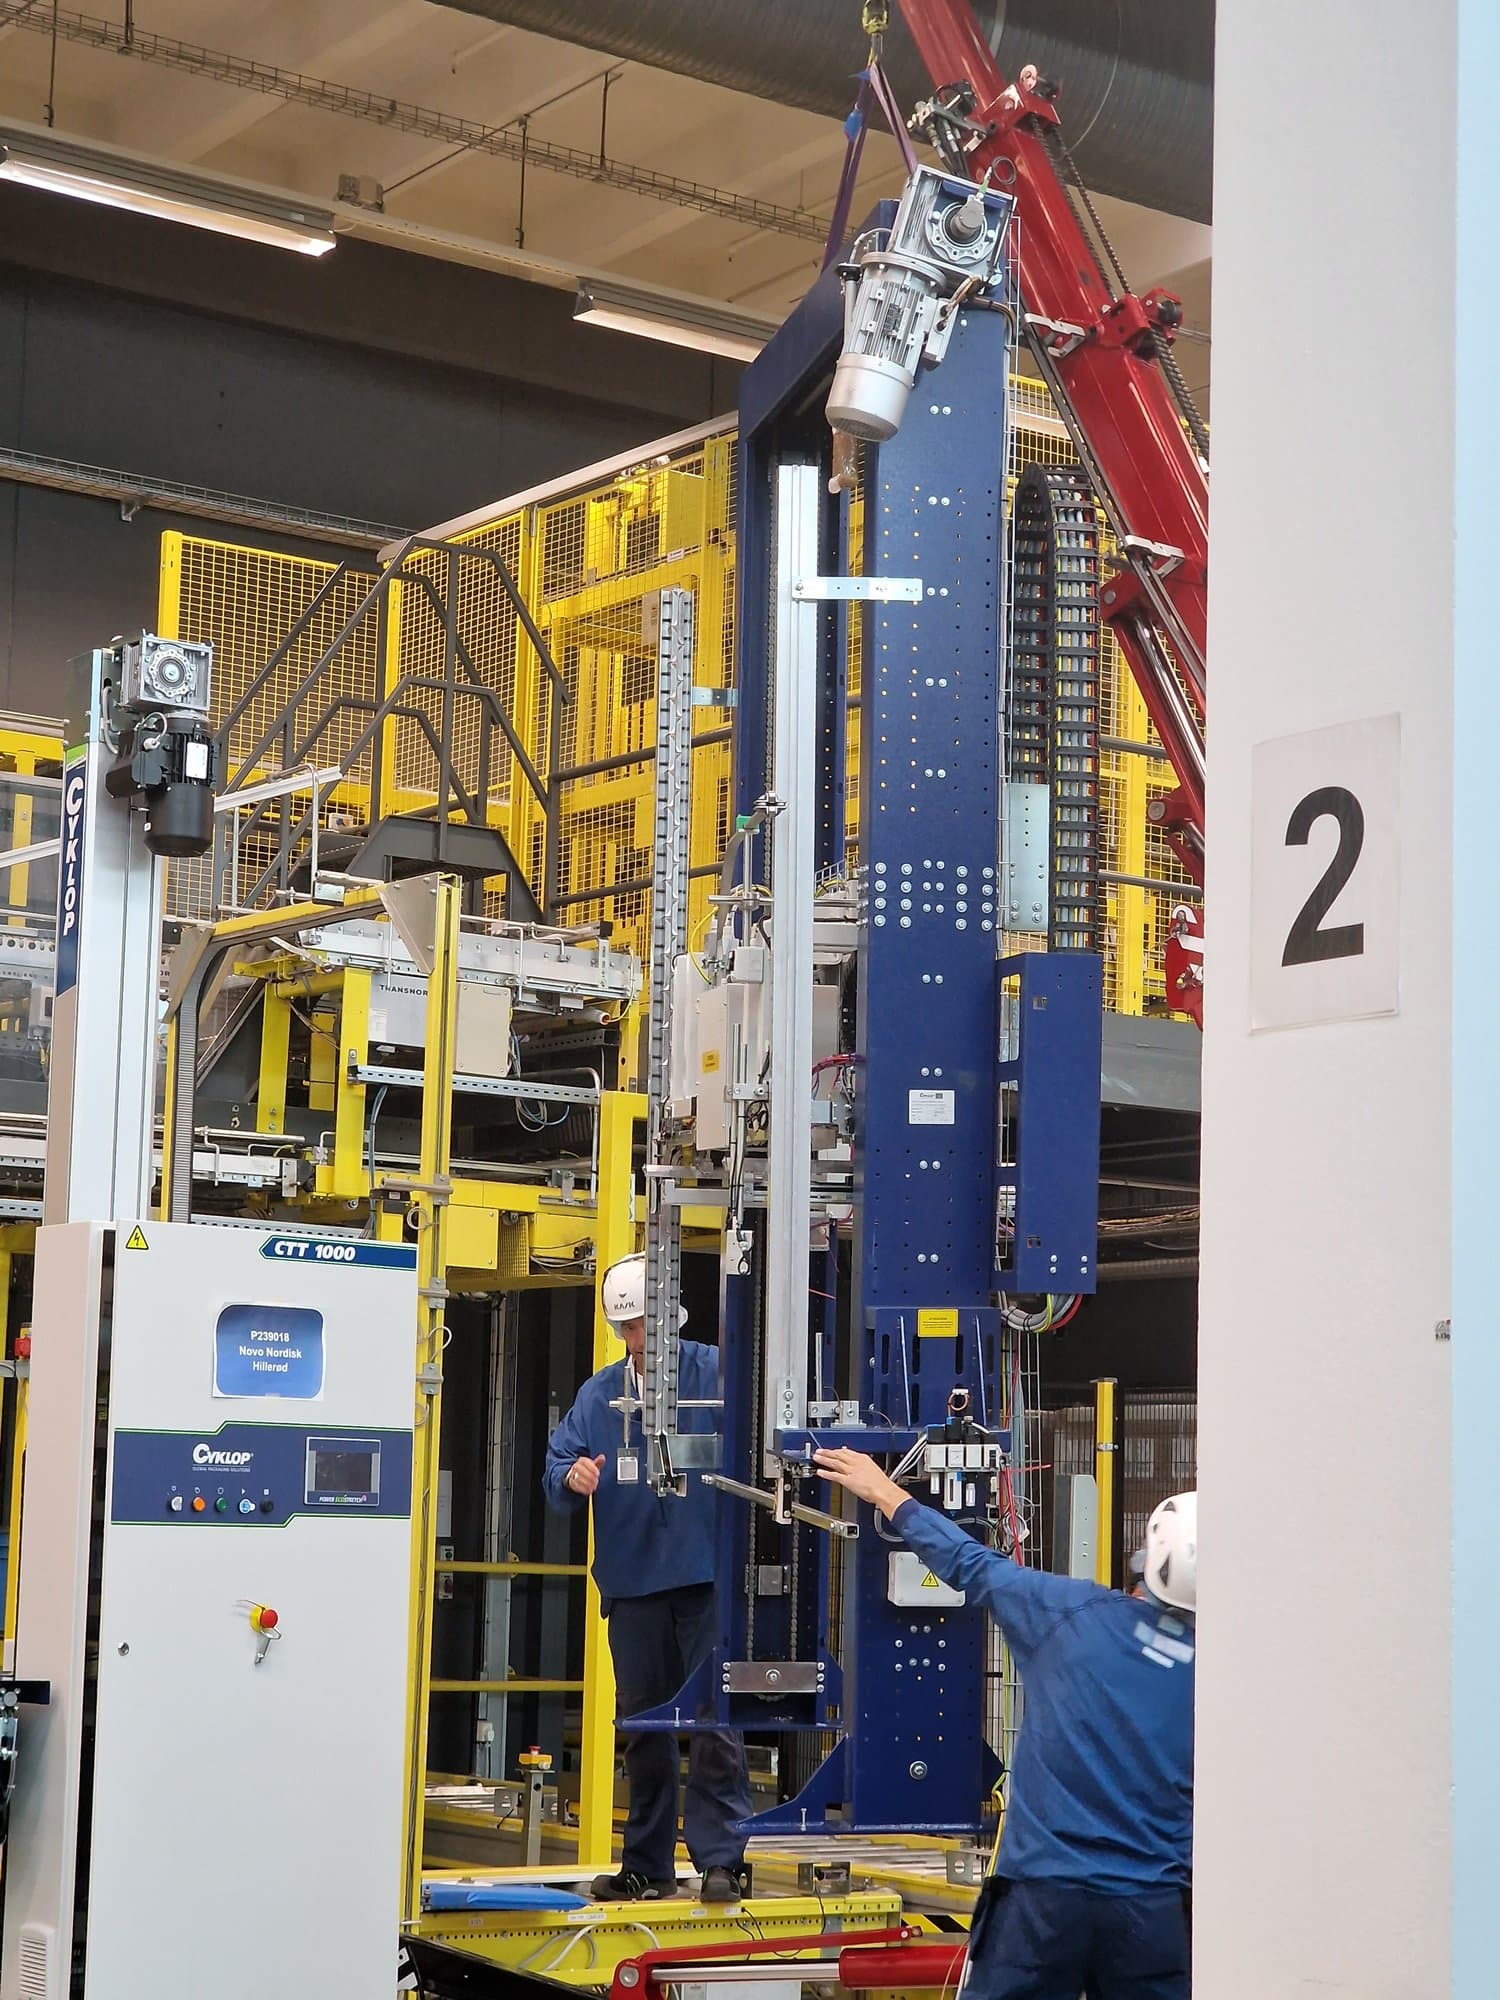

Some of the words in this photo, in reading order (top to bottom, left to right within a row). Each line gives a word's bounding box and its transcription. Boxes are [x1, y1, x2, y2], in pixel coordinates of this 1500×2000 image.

[63, 776, 85, 937] CYKLOP
[1281, 785, 1365, 967] 2
[274, 1240, 309, 1257] CTT
[315, 1243, 356, 1261] 1000
[250, 1330, 290, 1342] P239018
[239, 1345, 264, 1357] Novo
[266, 1346, 302, 1359] Nordisk
[252, 1360, 289, 1373] Hillerød
[192, 1443, 252, 1465] CYKLOP
